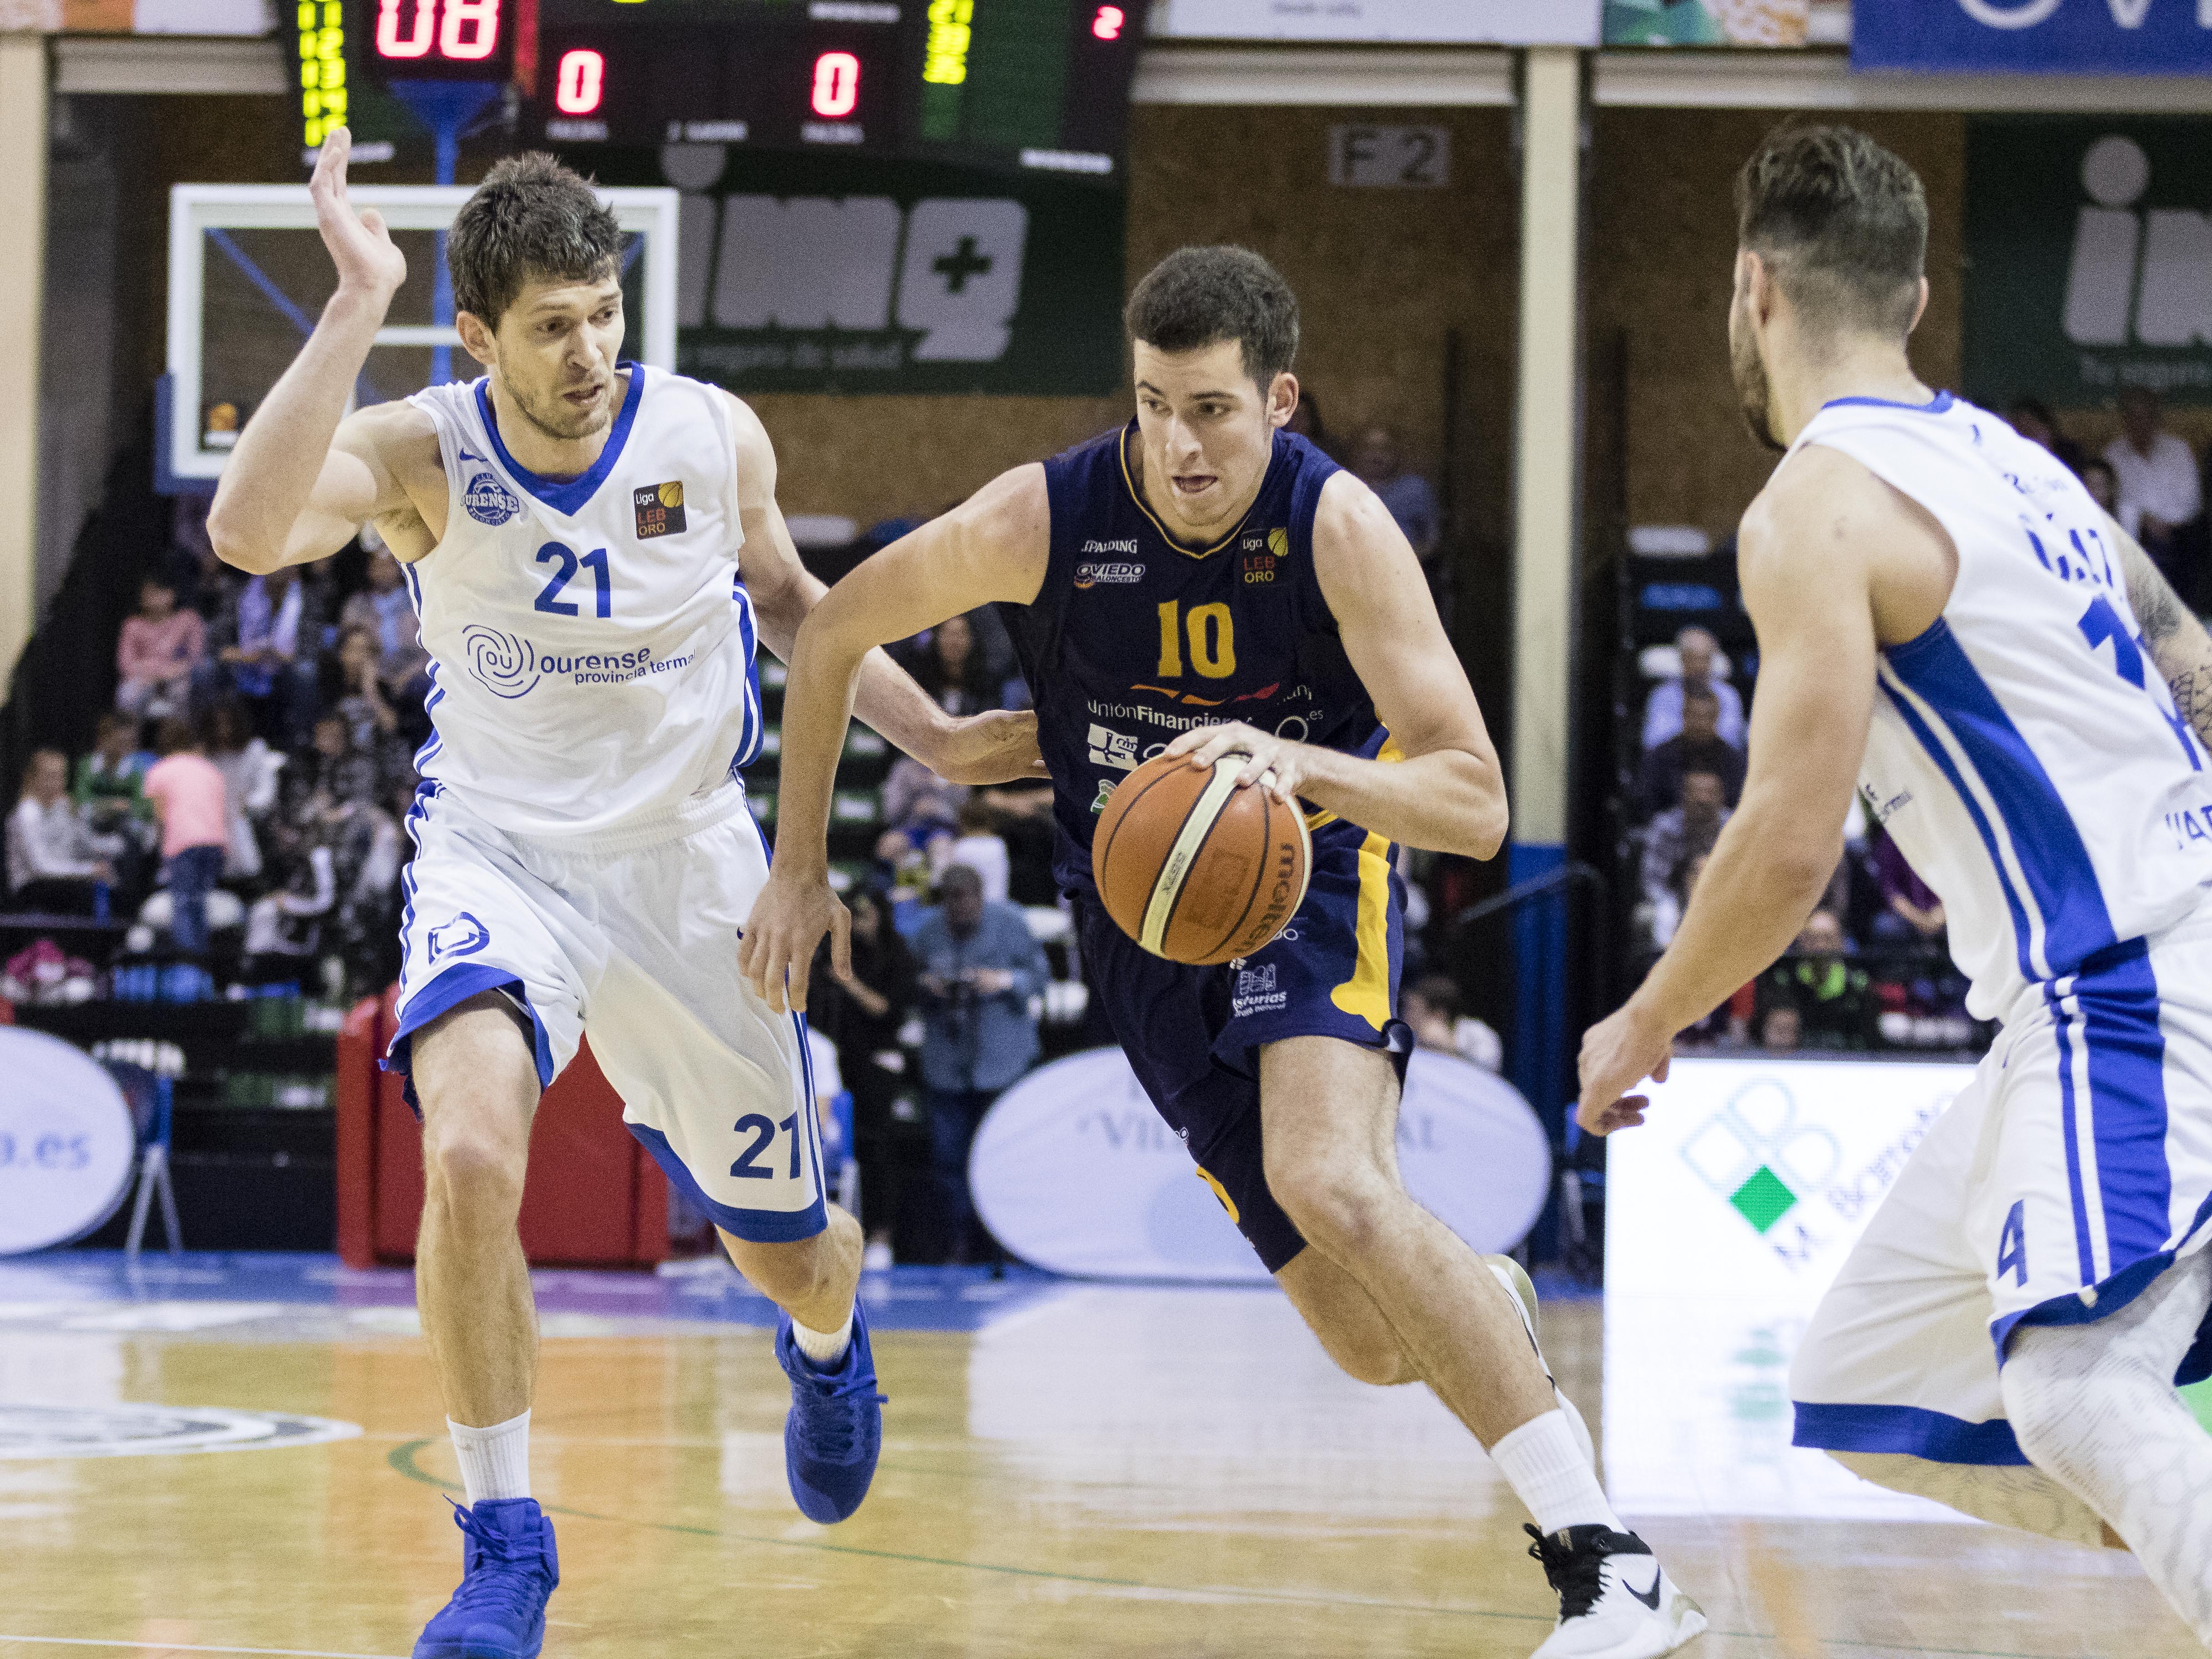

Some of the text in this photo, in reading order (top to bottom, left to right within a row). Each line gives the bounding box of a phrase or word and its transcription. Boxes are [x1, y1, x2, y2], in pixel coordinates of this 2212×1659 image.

[1093, 5, 1124, 40] 2
[556, 48, 605, 115] 0
[811, 51, 860, 117] 0
[1342, 131, 1438, 181] F 2
[636, 493, 654, 505] Liga
[637, 508, 665, 524] LEB
[638, 522, 665, 536] ORO
[1243, 538, 1262, 551] Liga
[1077, 563, 1146, 577] OVIEDO
[1244, 556, 1275, 571] LEB
[534, 541, 611, 618] 21
[1245, 570, 1274, 583] ORO
[1157, 599, 1237, 679] 10
[540, 647, 650, 674] ourense
[575, 666, 646, 685] provincia
[730, 1111, 801, 1180] 21
